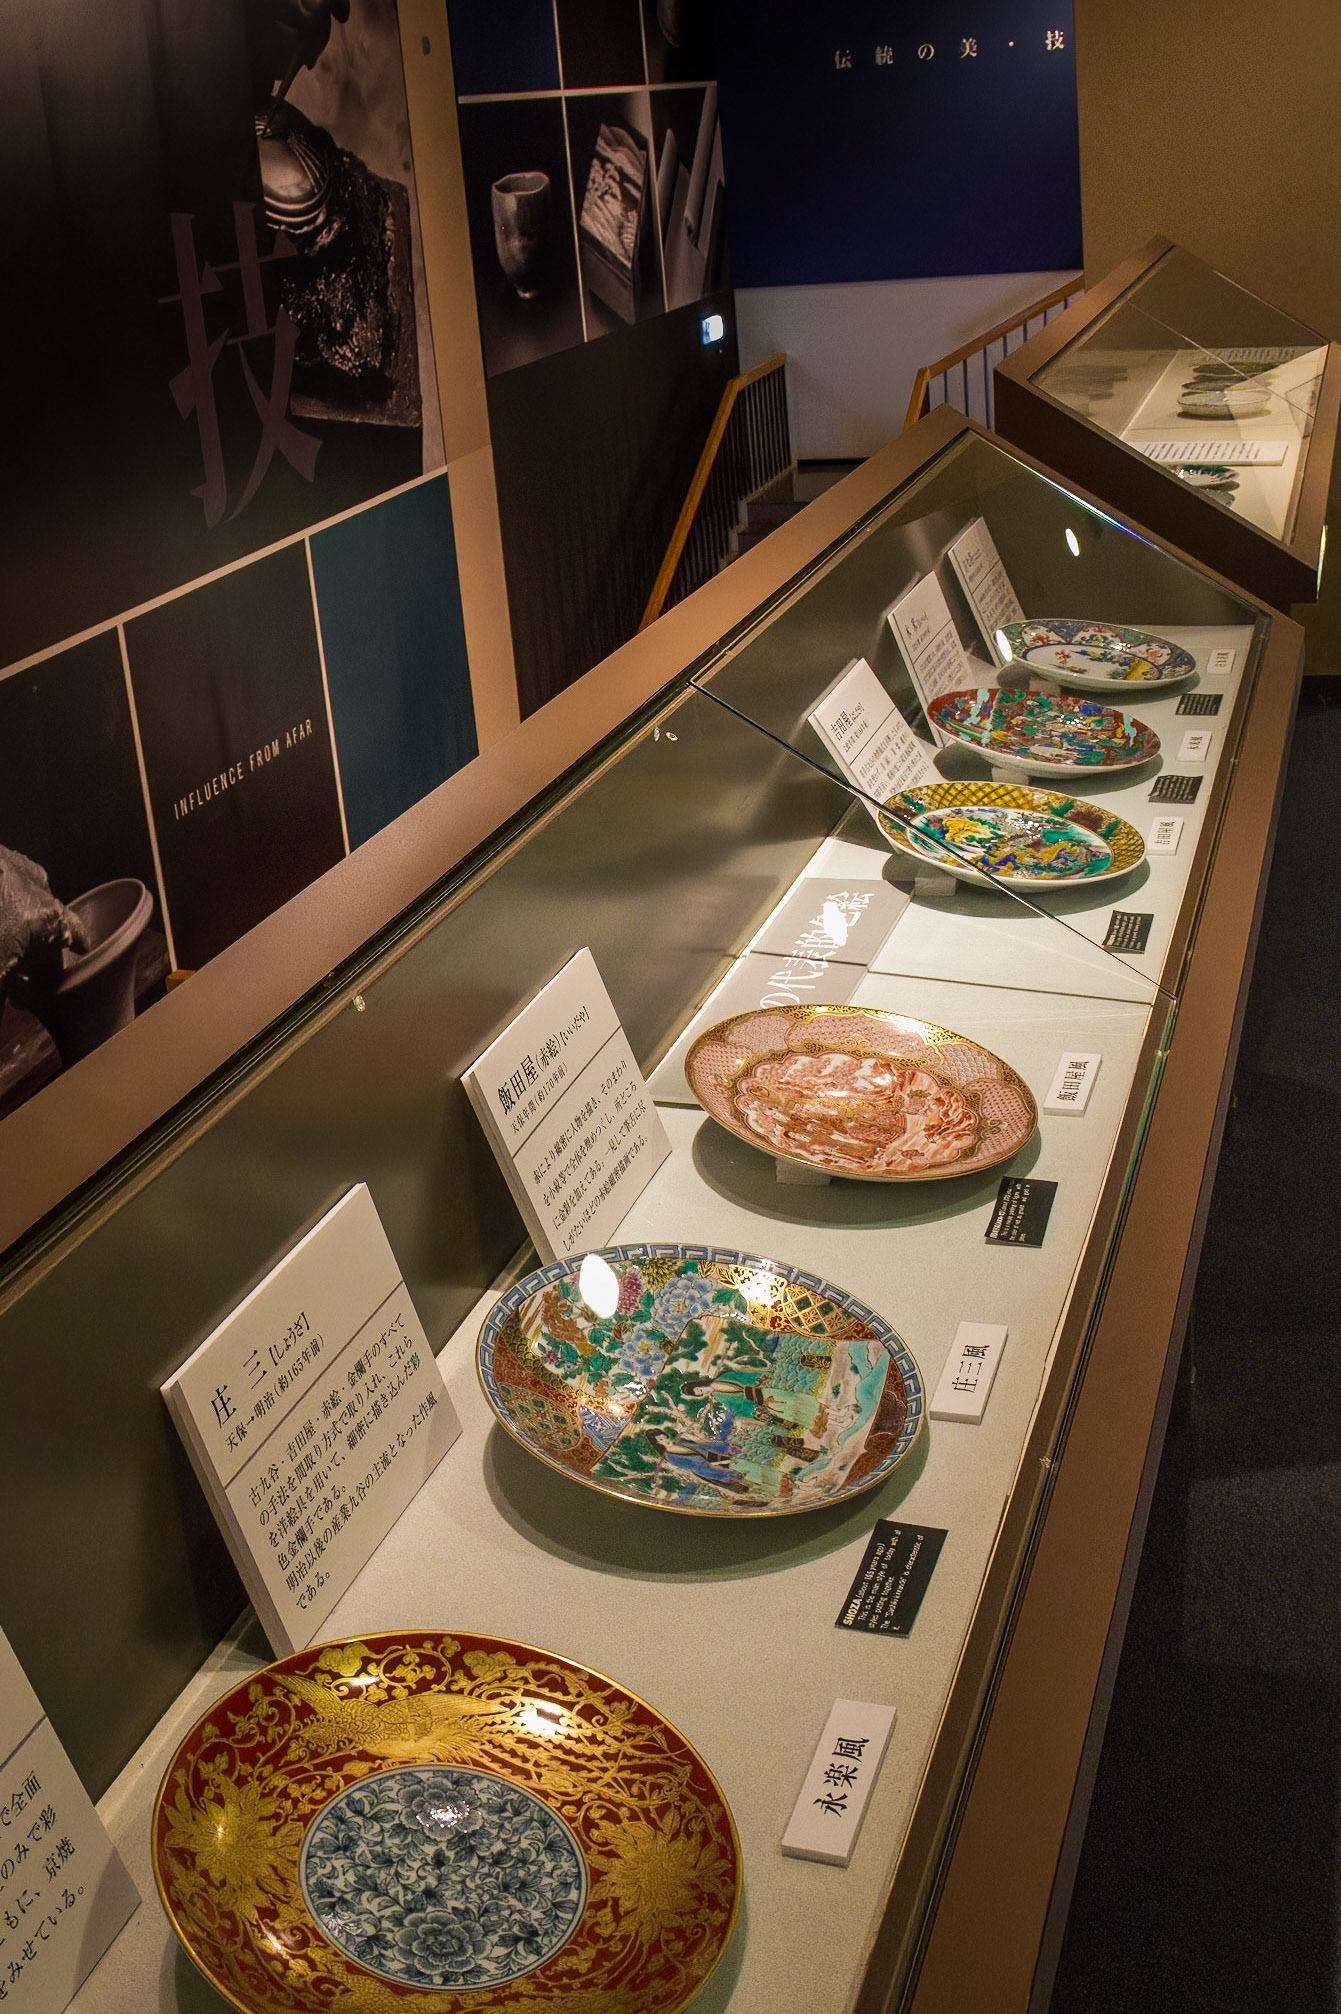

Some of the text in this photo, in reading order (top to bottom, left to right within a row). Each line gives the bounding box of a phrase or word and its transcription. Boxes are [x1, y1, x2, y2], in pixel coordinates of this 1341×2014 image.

[834, 30, 1065, 69] 伝統の美・技
[158, 201, 322, 528] 技
[174, 719, 313, 820] INFLUENCE FROM AFAR
[1056, 1061, 1090, 1102] 飯田屋風
[952, 1344, 991, 1393] 庄三風
[296, 1572, 331, 1611] である。
[842, 1598, 863, 1626] SHOZA
[813, 1737, 870, 1818] 永楽風
[0, 1804, 56, 1892] のみで彩
[0, 1836, 76, 1946] もに、京焼
